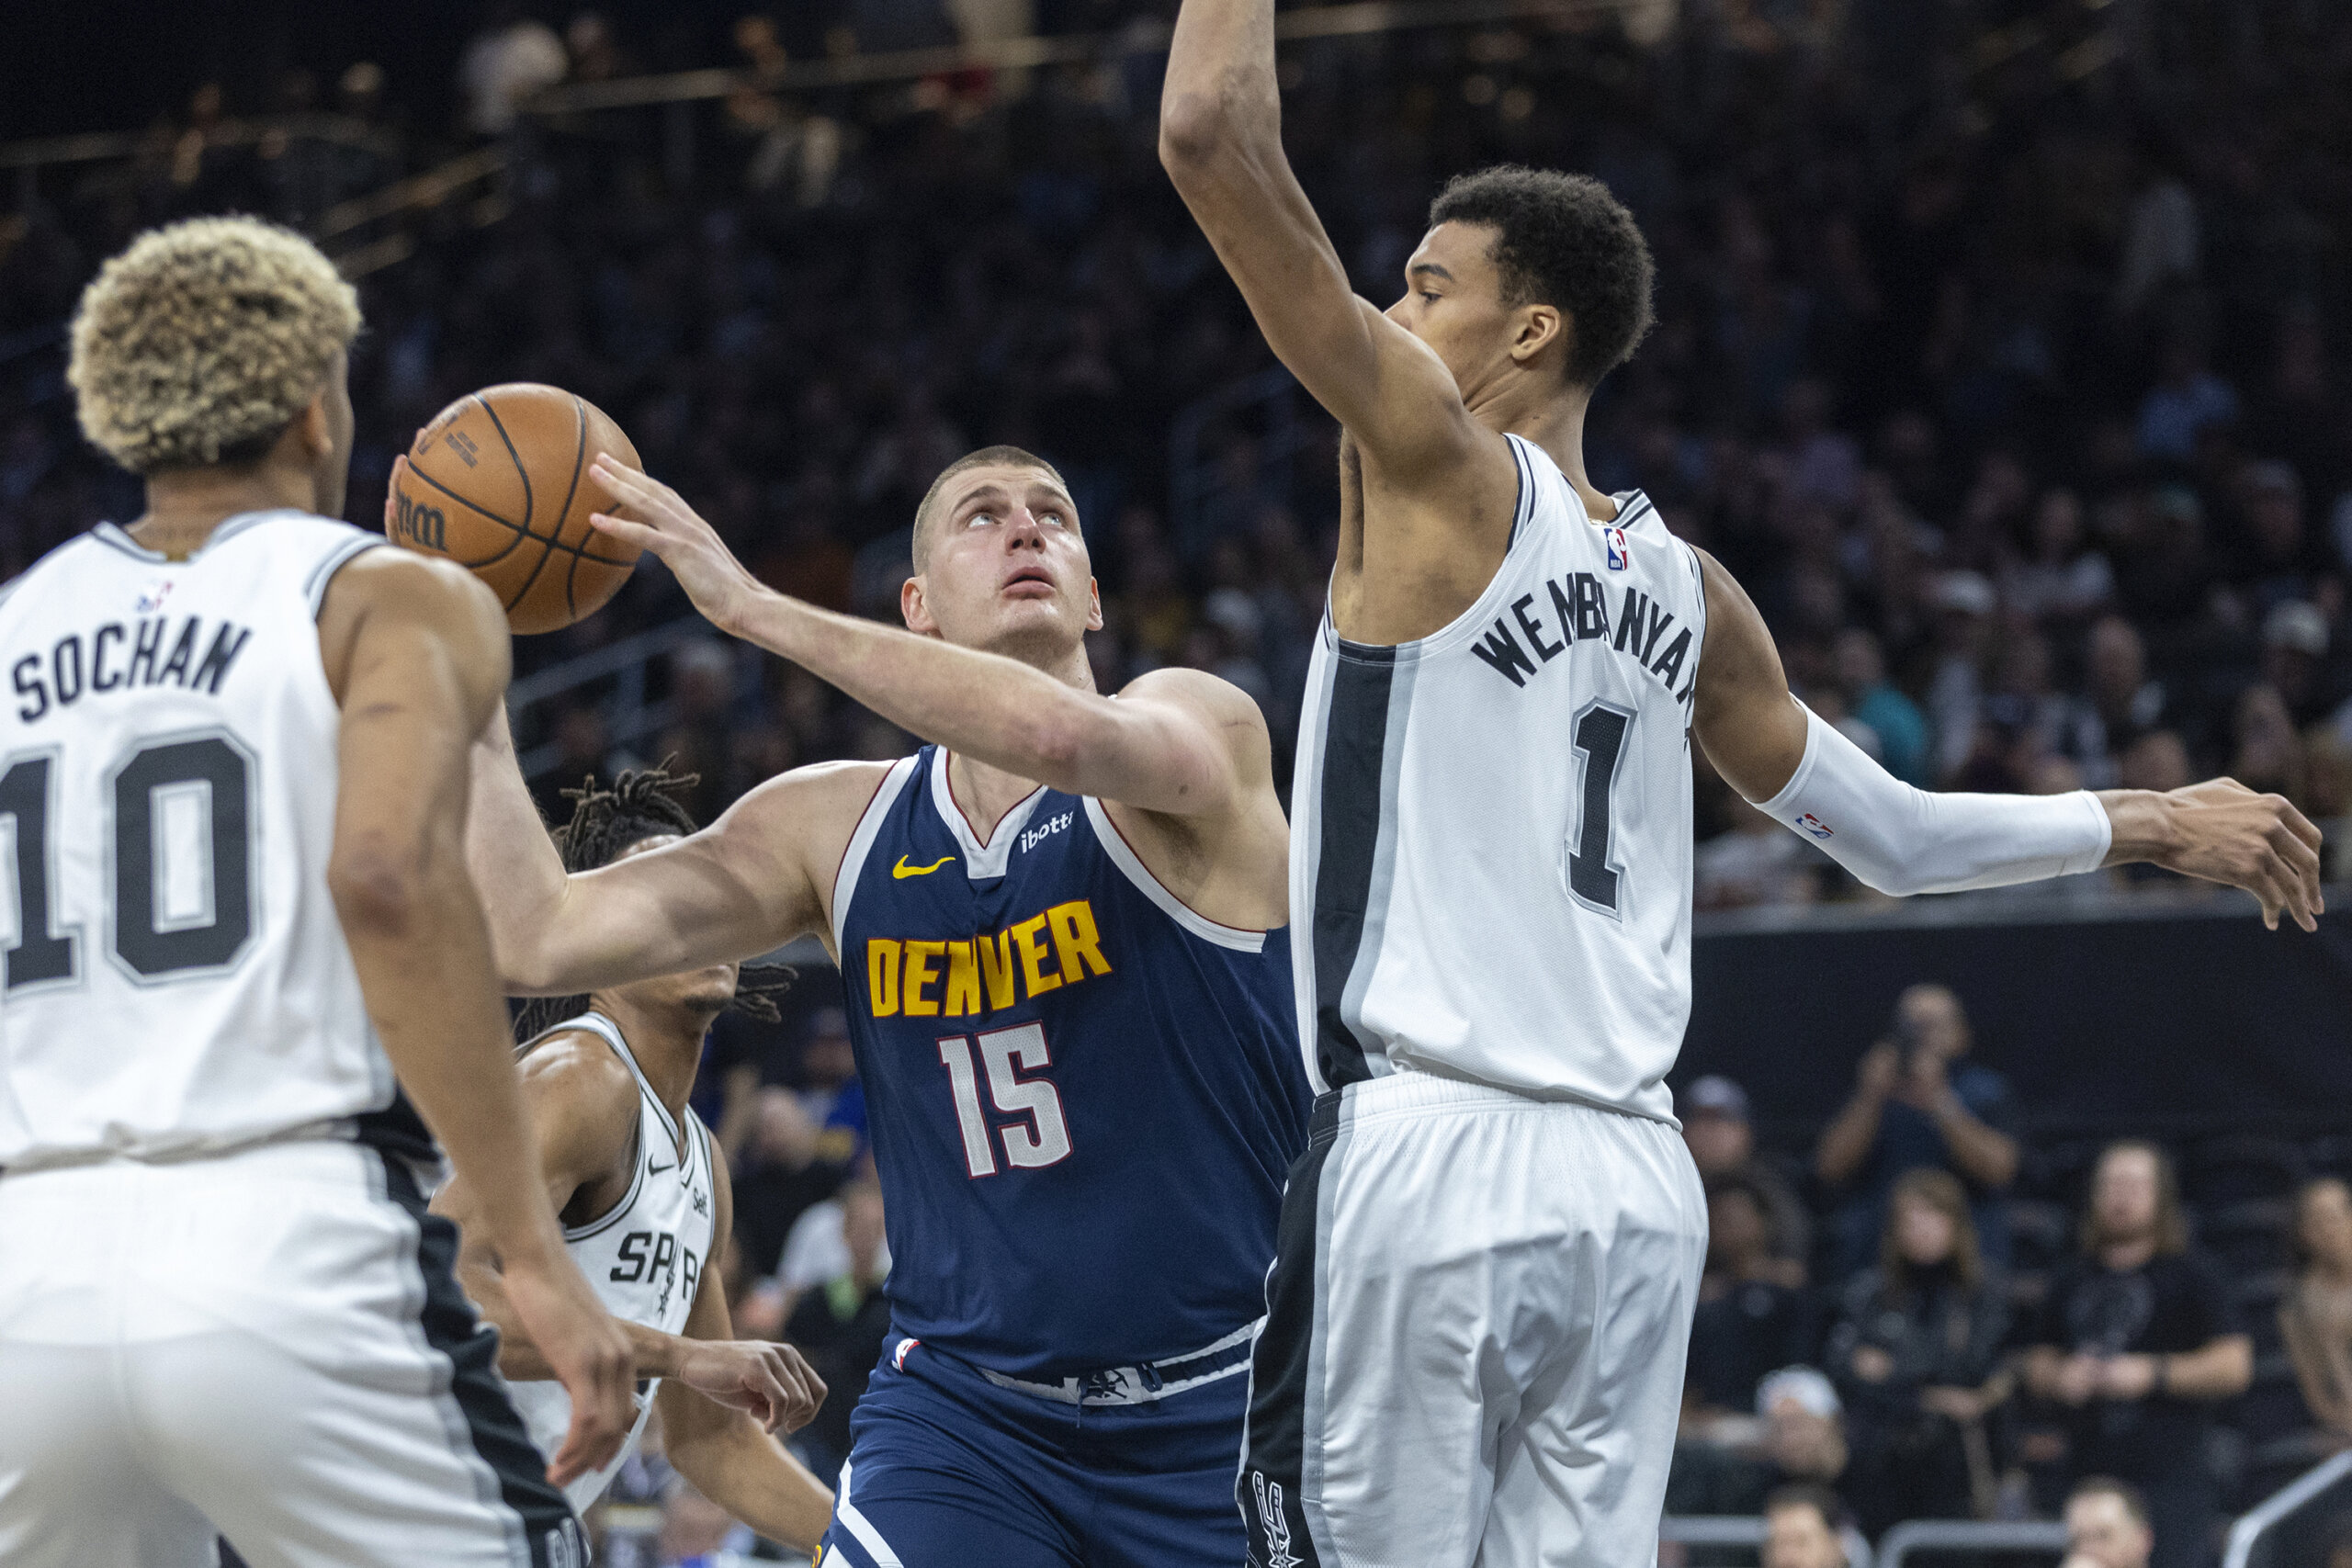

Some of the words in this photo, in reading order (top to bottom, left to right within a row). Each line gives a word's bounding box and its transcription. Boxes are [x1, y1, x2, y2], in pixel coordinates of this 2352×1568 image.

[12, 615, 253, 724] SOCHAN
[0, 723, 265, 1001] 10
[1564, 695, 1638, 923] 1
[867, 898, 1114, 1018] DENVER
[935, 1019, 1074, 1180] 15
